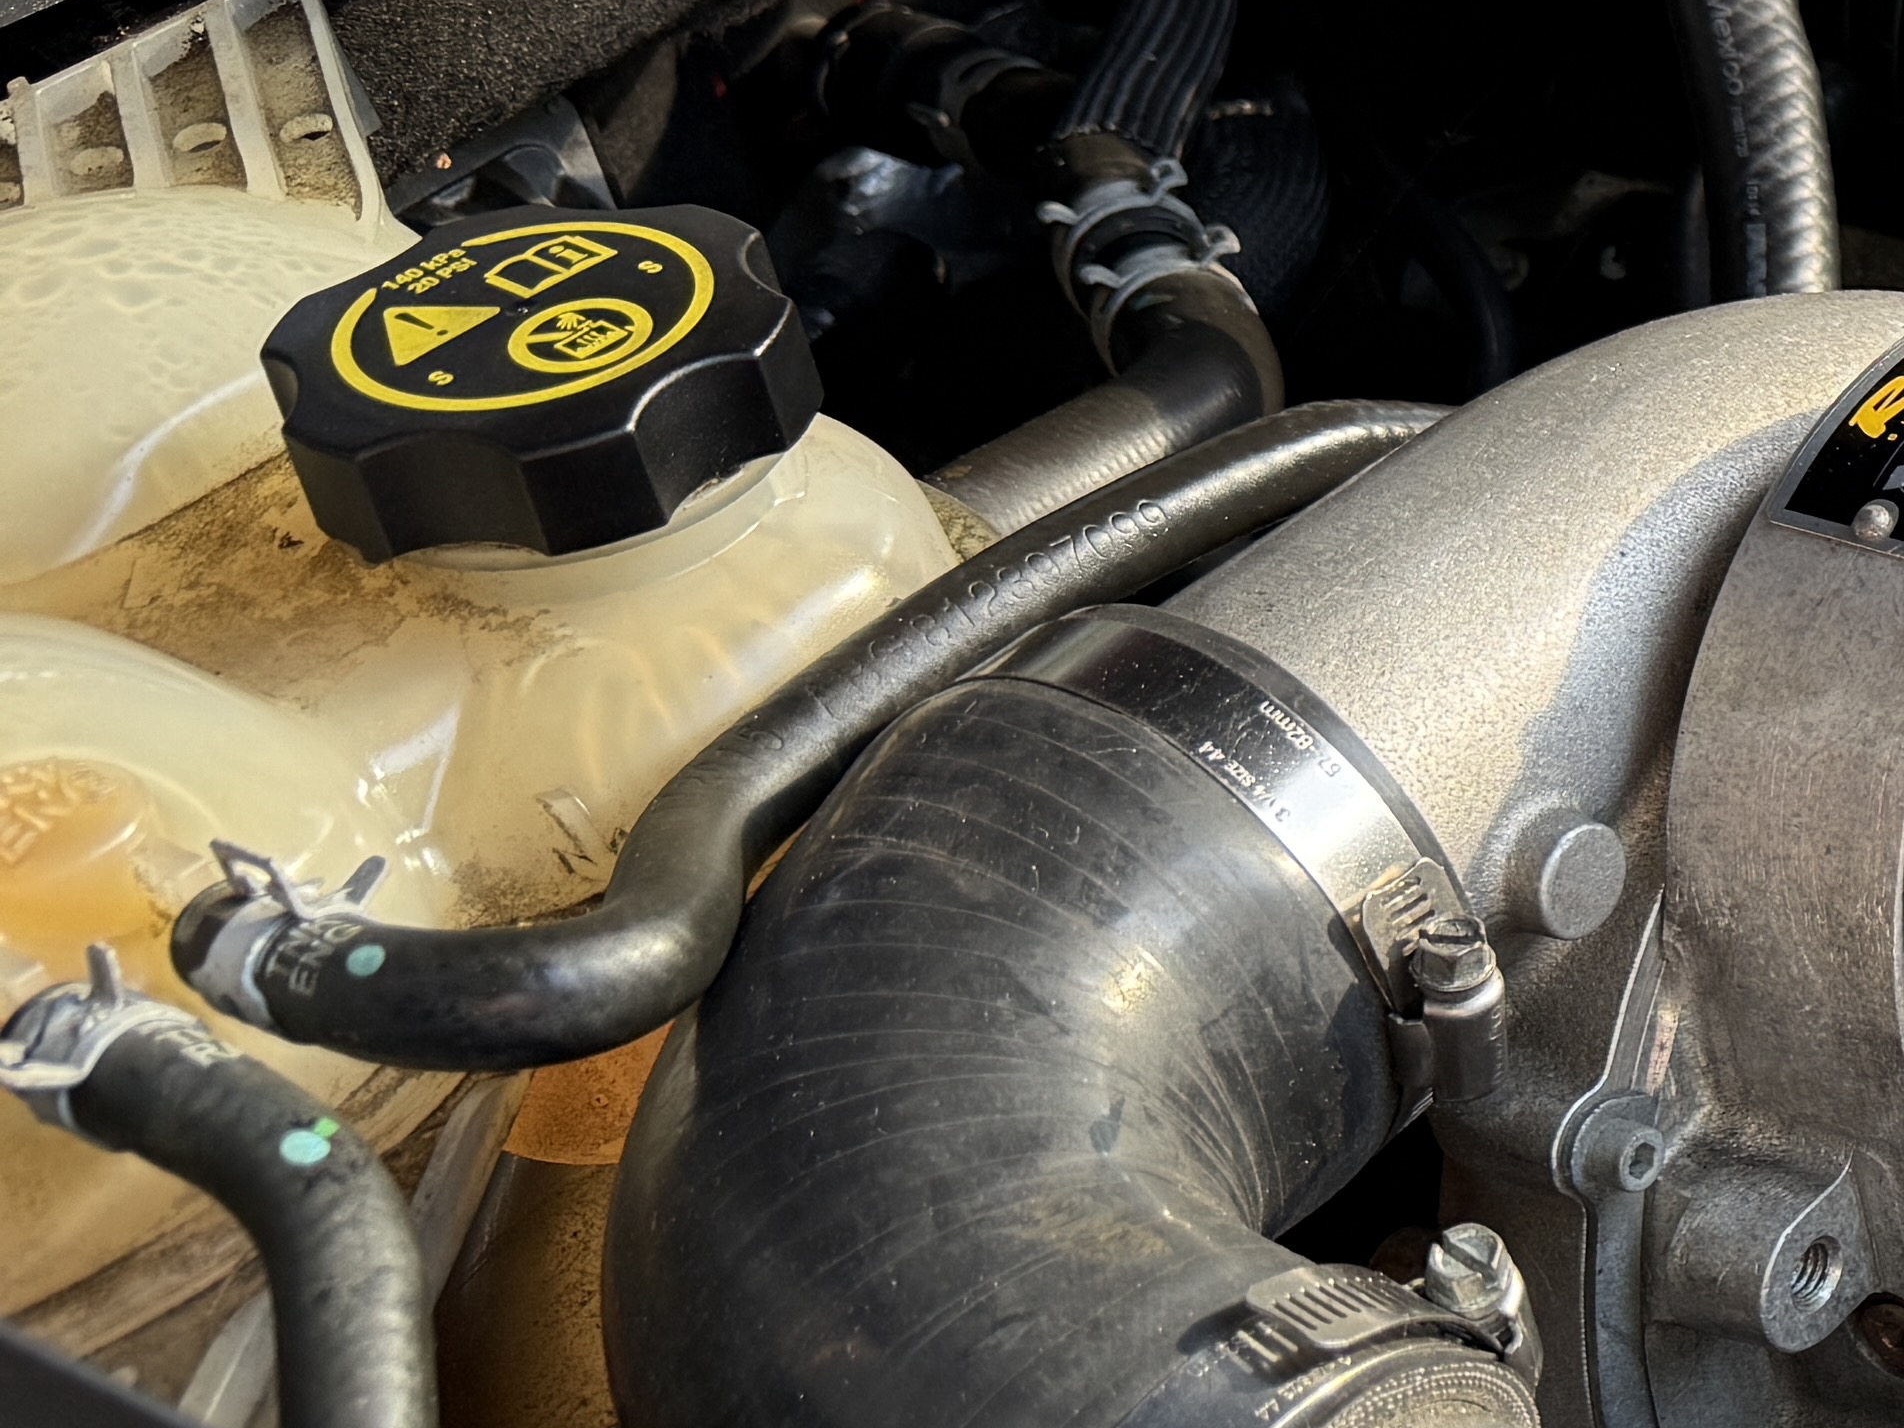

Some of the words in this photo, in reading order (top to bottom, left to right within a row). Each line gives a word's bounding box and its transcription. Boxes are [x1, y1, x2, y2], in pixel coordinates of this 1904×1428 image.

[381, 267, 425, 290] 140
[420, 249, 467, 271] kPa
[407, 276, 440, 295] 20
[435, 257, 478, 279] PSI
[1198, 740, 1227, 761] 44
[1224, 759, 1256, 788] SIZE
